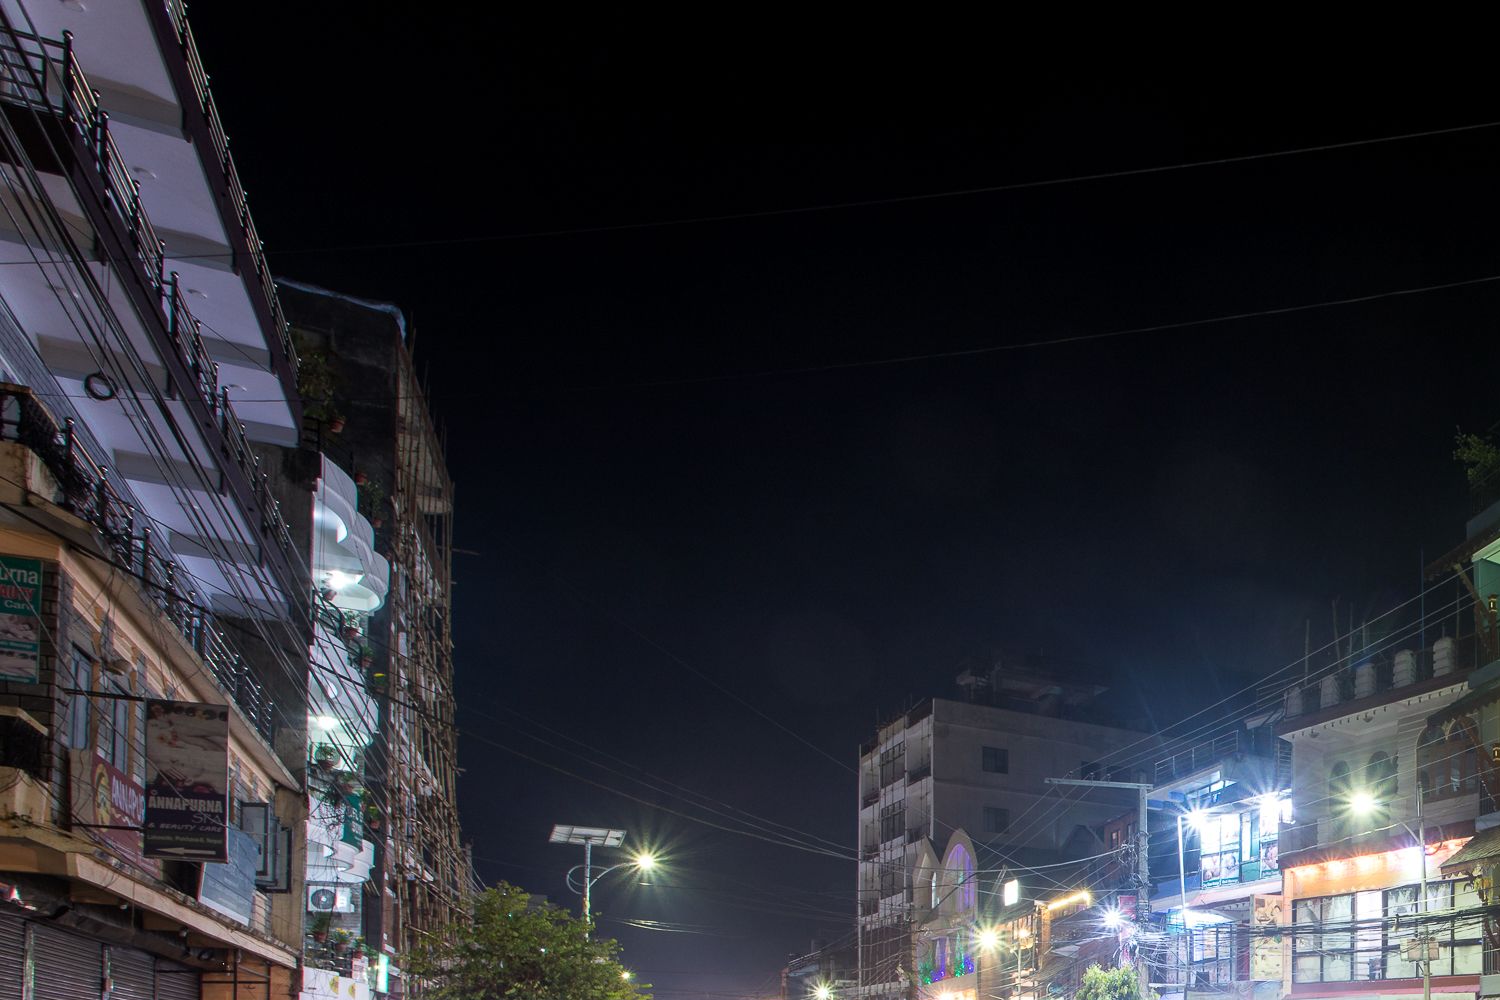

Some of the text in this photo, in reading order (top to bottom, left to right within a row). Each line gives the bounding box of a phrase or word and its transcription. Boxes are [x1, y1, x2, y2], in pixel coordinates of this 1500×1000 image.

[148, 795, 223, 814] ANNAPURNA
[160, 823, 196, 832] BEAUTY
[200, 825, 223, 833] CARE
